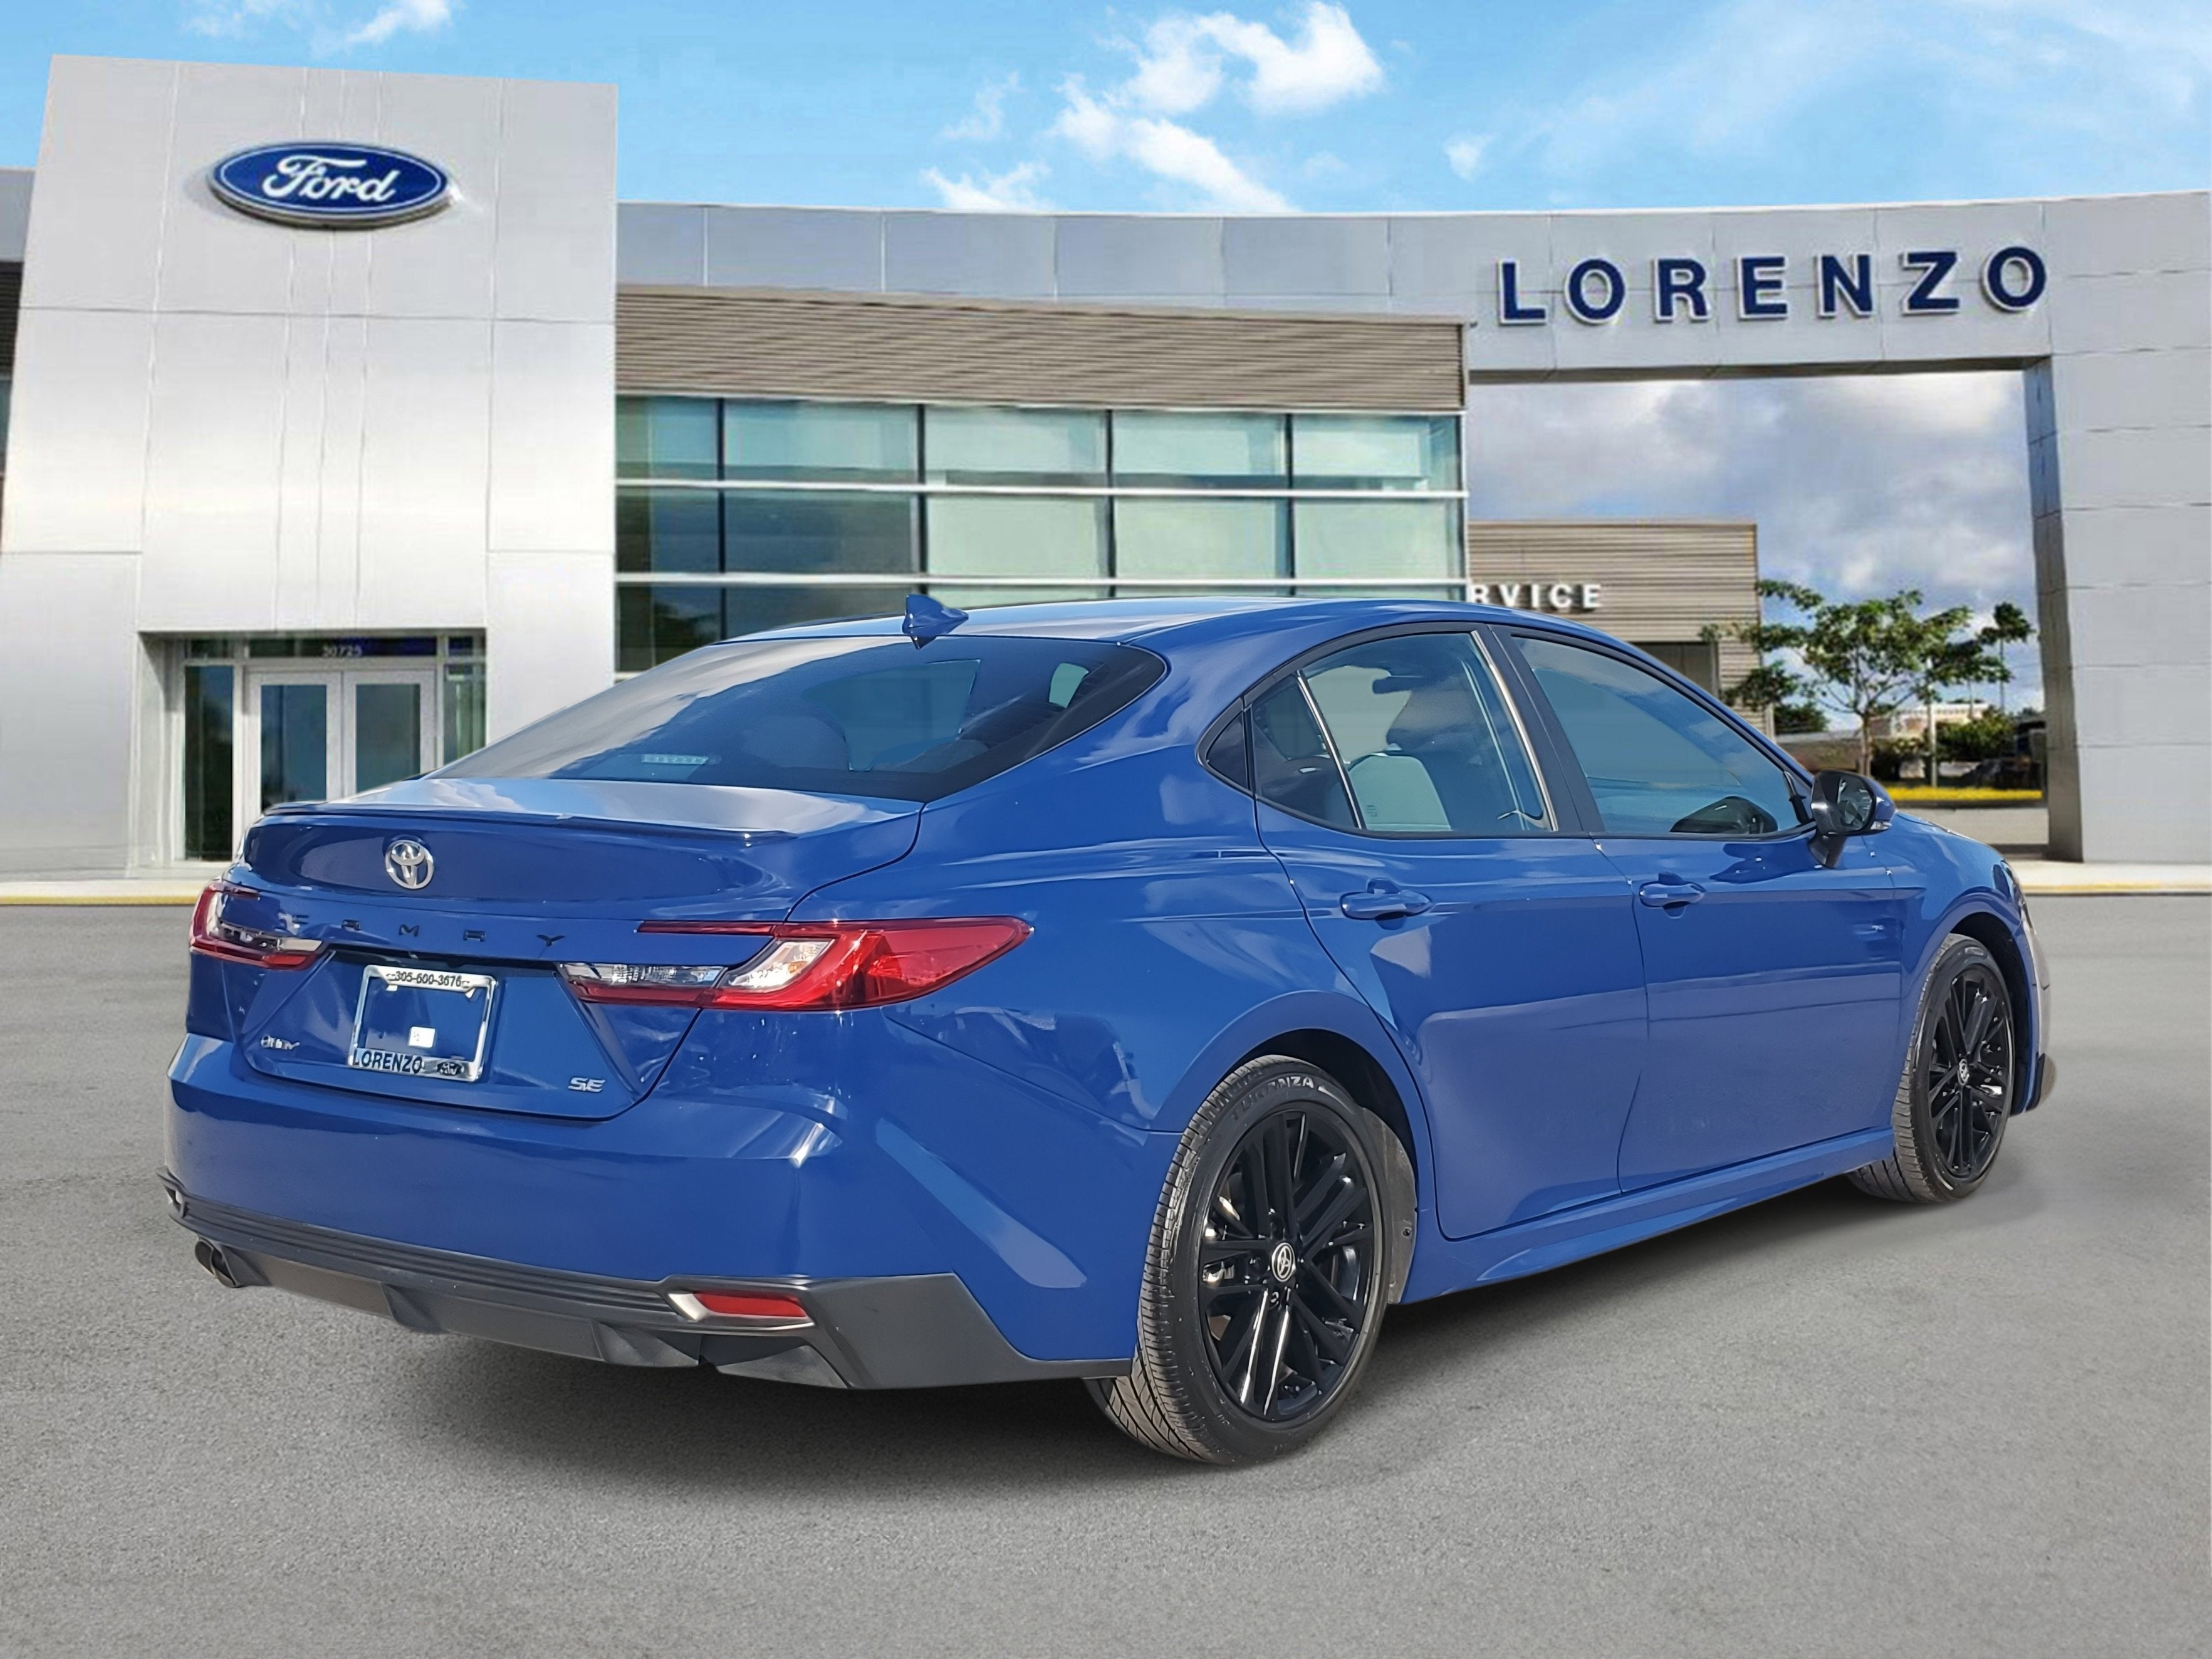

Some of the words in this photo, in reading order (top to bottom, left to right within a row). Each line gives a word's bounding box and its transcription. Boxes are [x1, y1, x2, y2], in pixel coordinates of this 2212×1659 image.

[262, 154, 401, 202] Ford
[1499, 246, 2048, 325] LORENZO
[352, 1050, 423, 1074] LORENZO
[568, 1077, 606, 1092] SE
